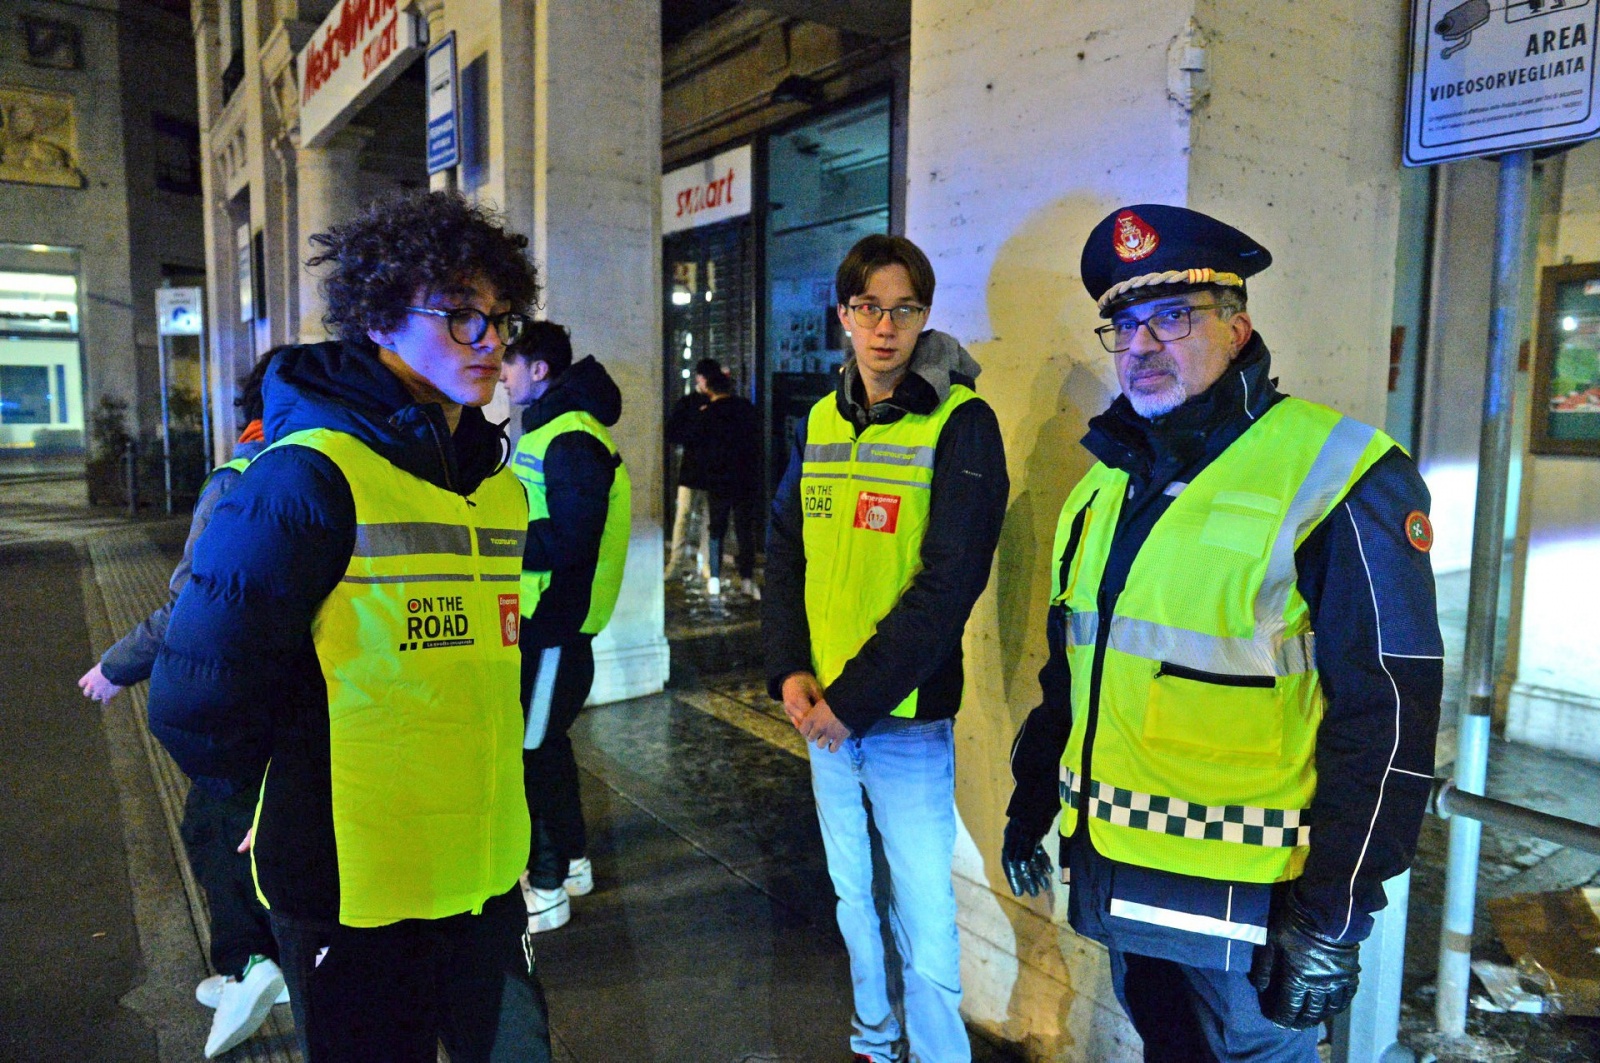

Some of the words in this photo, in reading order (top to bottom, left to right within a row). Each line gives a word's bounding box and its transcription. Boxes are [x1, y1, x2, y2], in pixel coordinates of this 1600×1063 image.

[1525, 23, 1587, 57] AREA
[1430, 56, 1585, 101] VIDEOSORVEGLIATA
[806, 486, 815, 495] ON
[818, 485, 833, 496] THE
[805, 497, 832, 511] ROAD
[407, 598, 433, 613] ON
[436, 596, 464, 612] THE
[408, 614, 469, 640] ROAD
